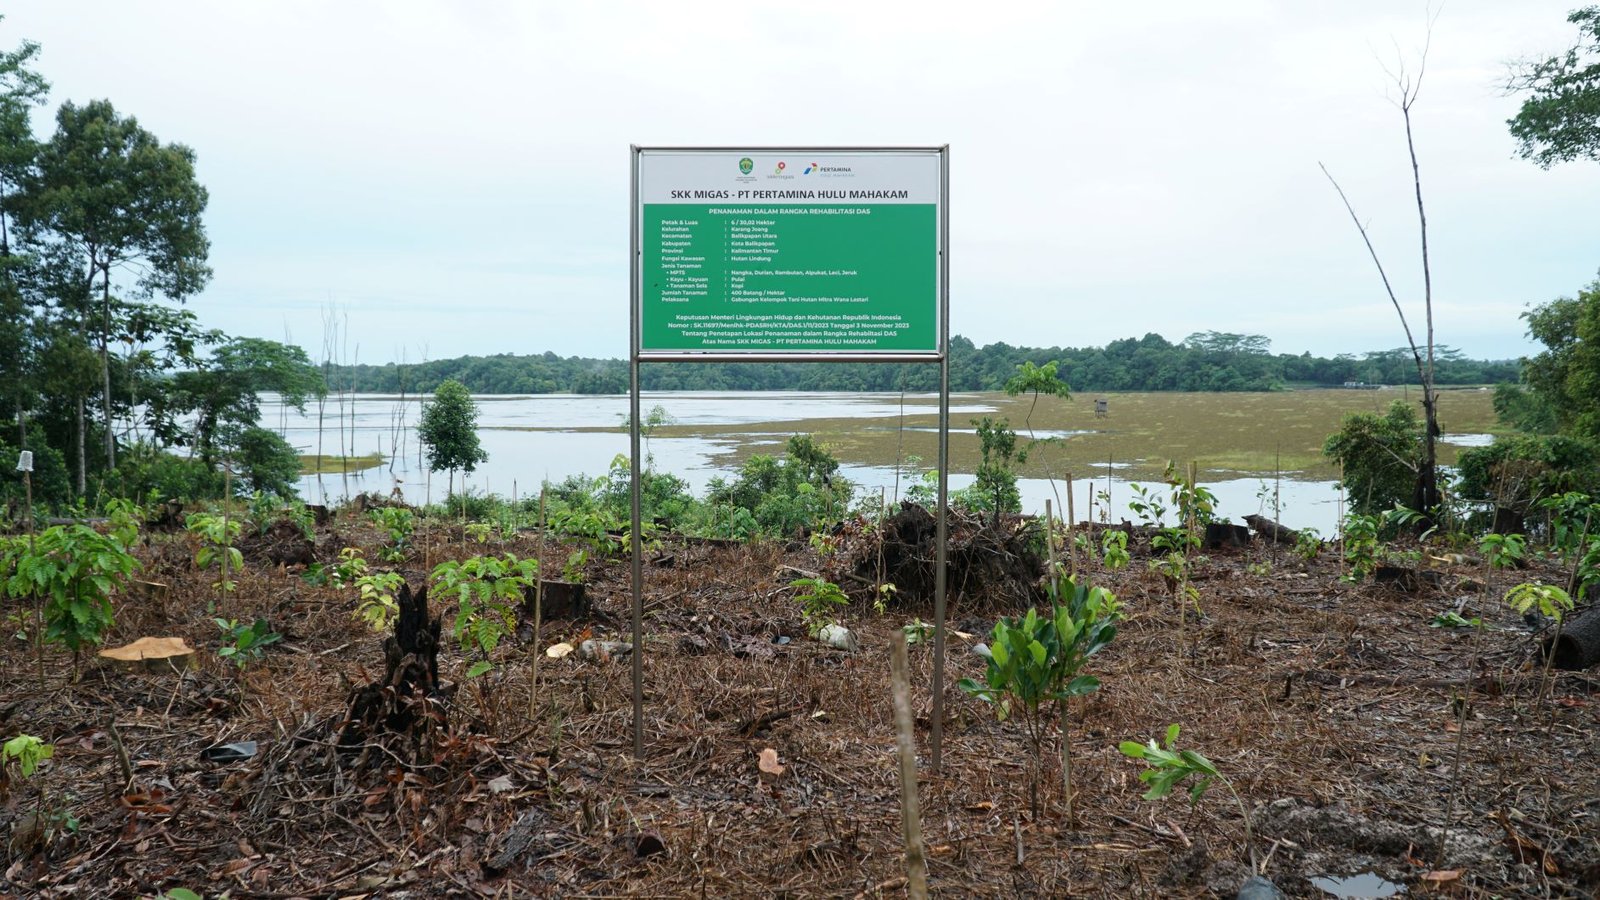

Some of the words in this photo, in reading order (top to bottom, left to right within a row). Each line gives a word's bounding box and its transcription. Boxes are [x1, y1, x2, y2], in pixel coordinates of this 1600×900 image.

[671, 190, 692, 200] SKK
[694, 190, 729, 200] MIGAS
[738, 190, 750, 200] PT
[753, 190, 815, 200] PERTAMINA
[818, 190, 846, 200] HULU
[850, 190, 909, 200] MAHAKAM
[662, 240, 691, 248] Kabupaten
[745, 240, 775, 248] Balikpapan
[662, 255, 680, 263] Fungsi
[749, 255, 771, 263] Lindung
[670, 276, 684, 284] Kayu
[731, 296, 759, 304] Gabungan
[760, 296, 787, 304] Kelompok
[676, 314, 709, 322] Keputusan
[736, 314, 772, 322] Lingkungan
[774, 314, 793, 322] Hidup
[842, 314, 870, 322] Republik
[830, 322, 855, 330] Tanggal
[682, 330, 707, 338] Tentang
[708, 330, 742, 338] Penetapan
[823, 330, 847, 338] Rangka
